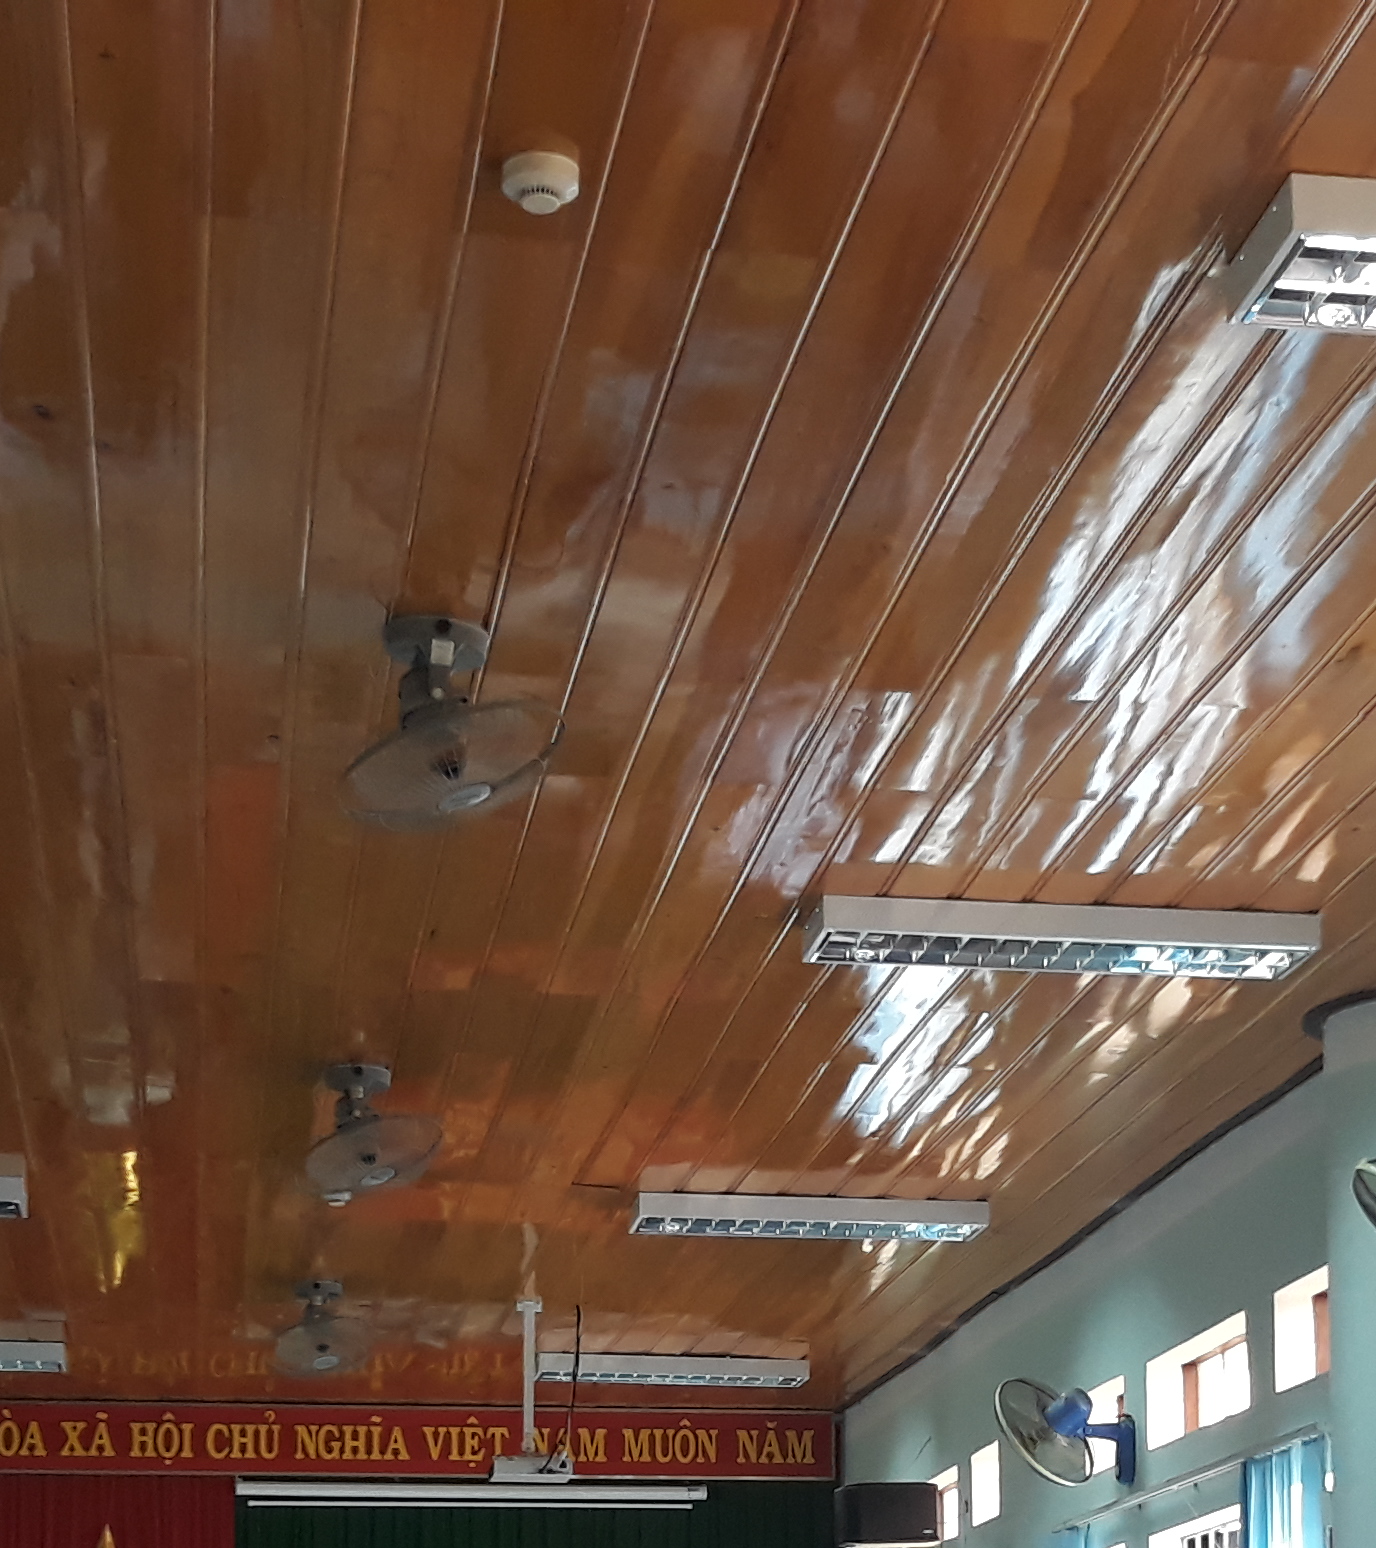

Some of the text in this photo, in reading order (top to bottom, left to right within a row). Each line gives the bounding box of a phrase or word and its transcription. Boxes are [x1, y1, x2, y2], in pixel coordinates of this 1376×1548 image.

[129, 1411, 194, 1465] HỘI
[206, 1410, 281, 1459] CHỦ
[294, 1415, 411, 1460] NGHĨA
[422, 1416, 510, 1467] VIỆT
[622, 1418, 719, 1463] MUÔN
[736, 1420, 816, 1464] NĂM
